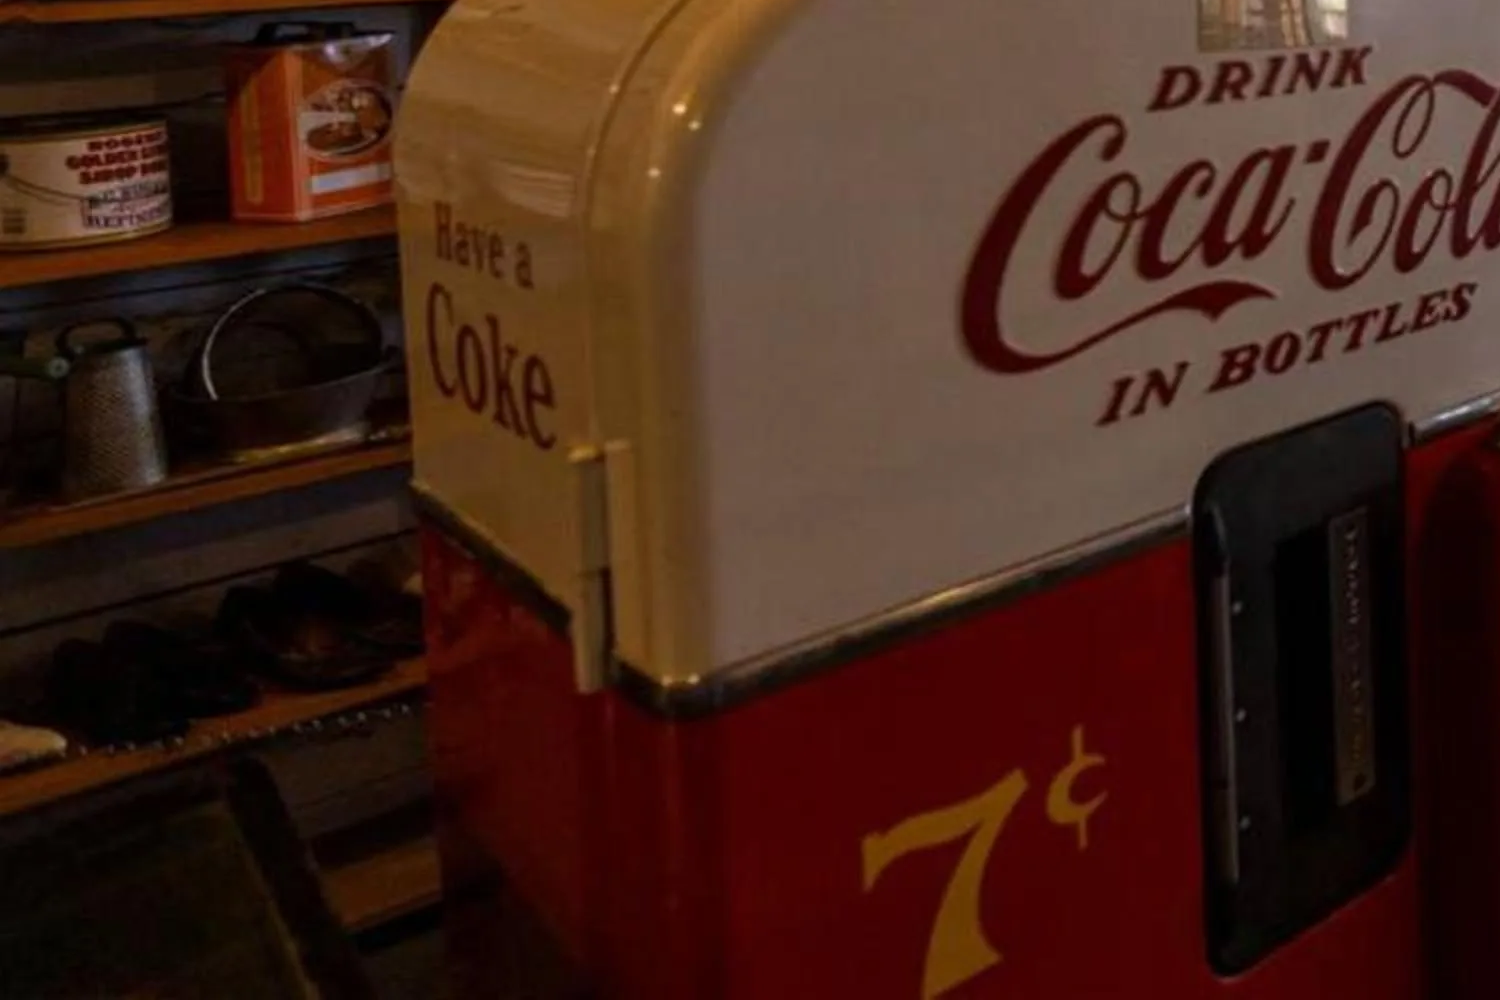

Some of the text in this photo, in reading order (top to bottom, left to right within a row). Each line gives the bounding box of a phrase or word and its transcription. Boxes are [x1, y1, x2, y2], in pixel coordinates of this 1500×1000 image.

[1146, 45, 1375, 113] DRINK
[434, 201, 535, 290] Have a
[426, 281, 557, 451] Coke
[1095, 282, 1479, 428] IN BOTTLES
